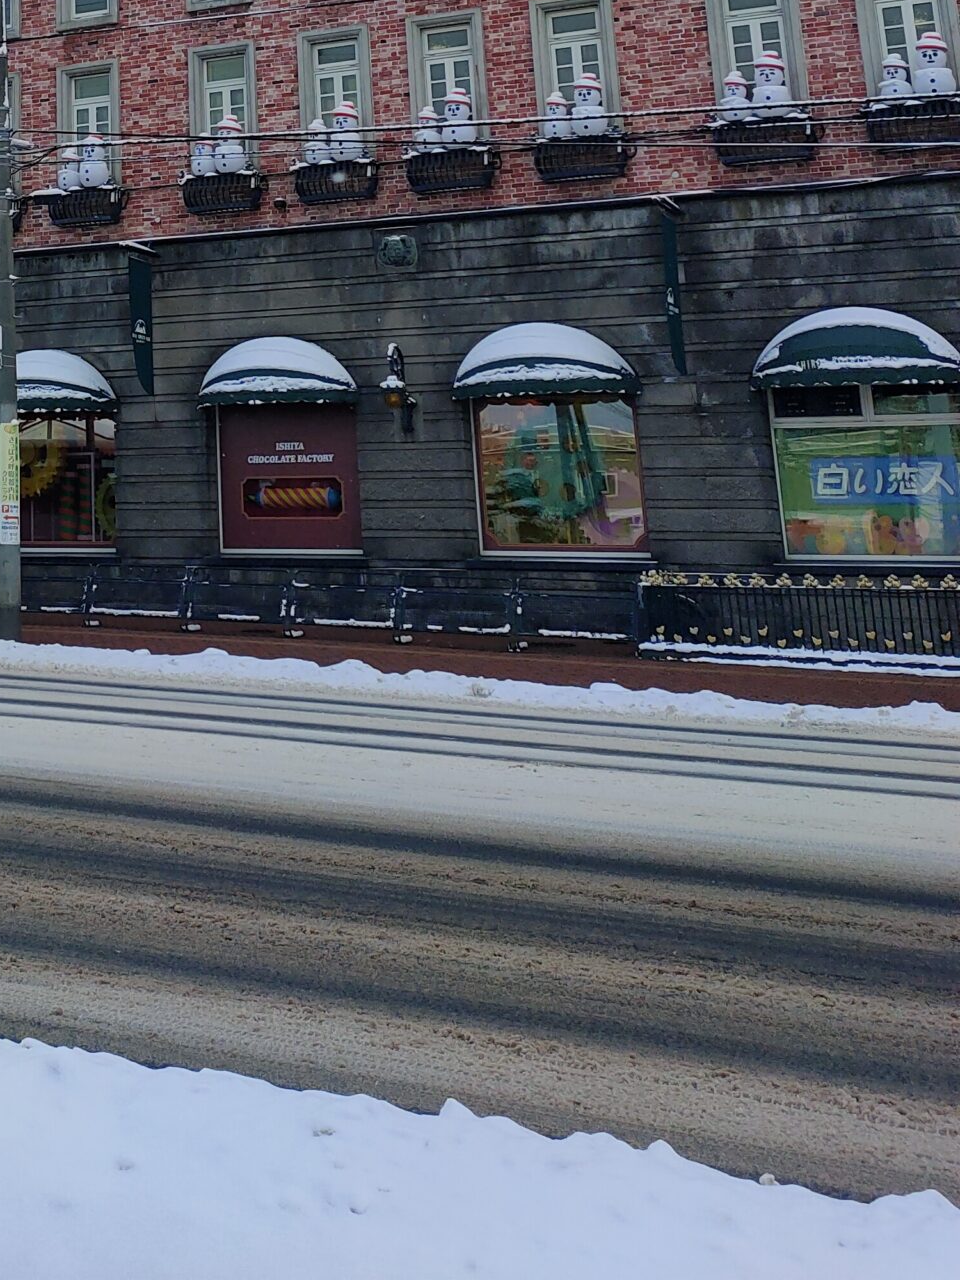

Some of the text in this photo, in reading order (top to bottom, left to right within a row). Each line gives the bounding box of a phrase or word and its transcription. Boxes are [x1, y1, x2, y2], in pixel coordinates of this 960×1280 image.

[275, 442, 304, 451] ISHIYA
[247, 453, 335, 464] CHOCOLATE FACTORY
[816, 462, 955, 496] 白い恋人
